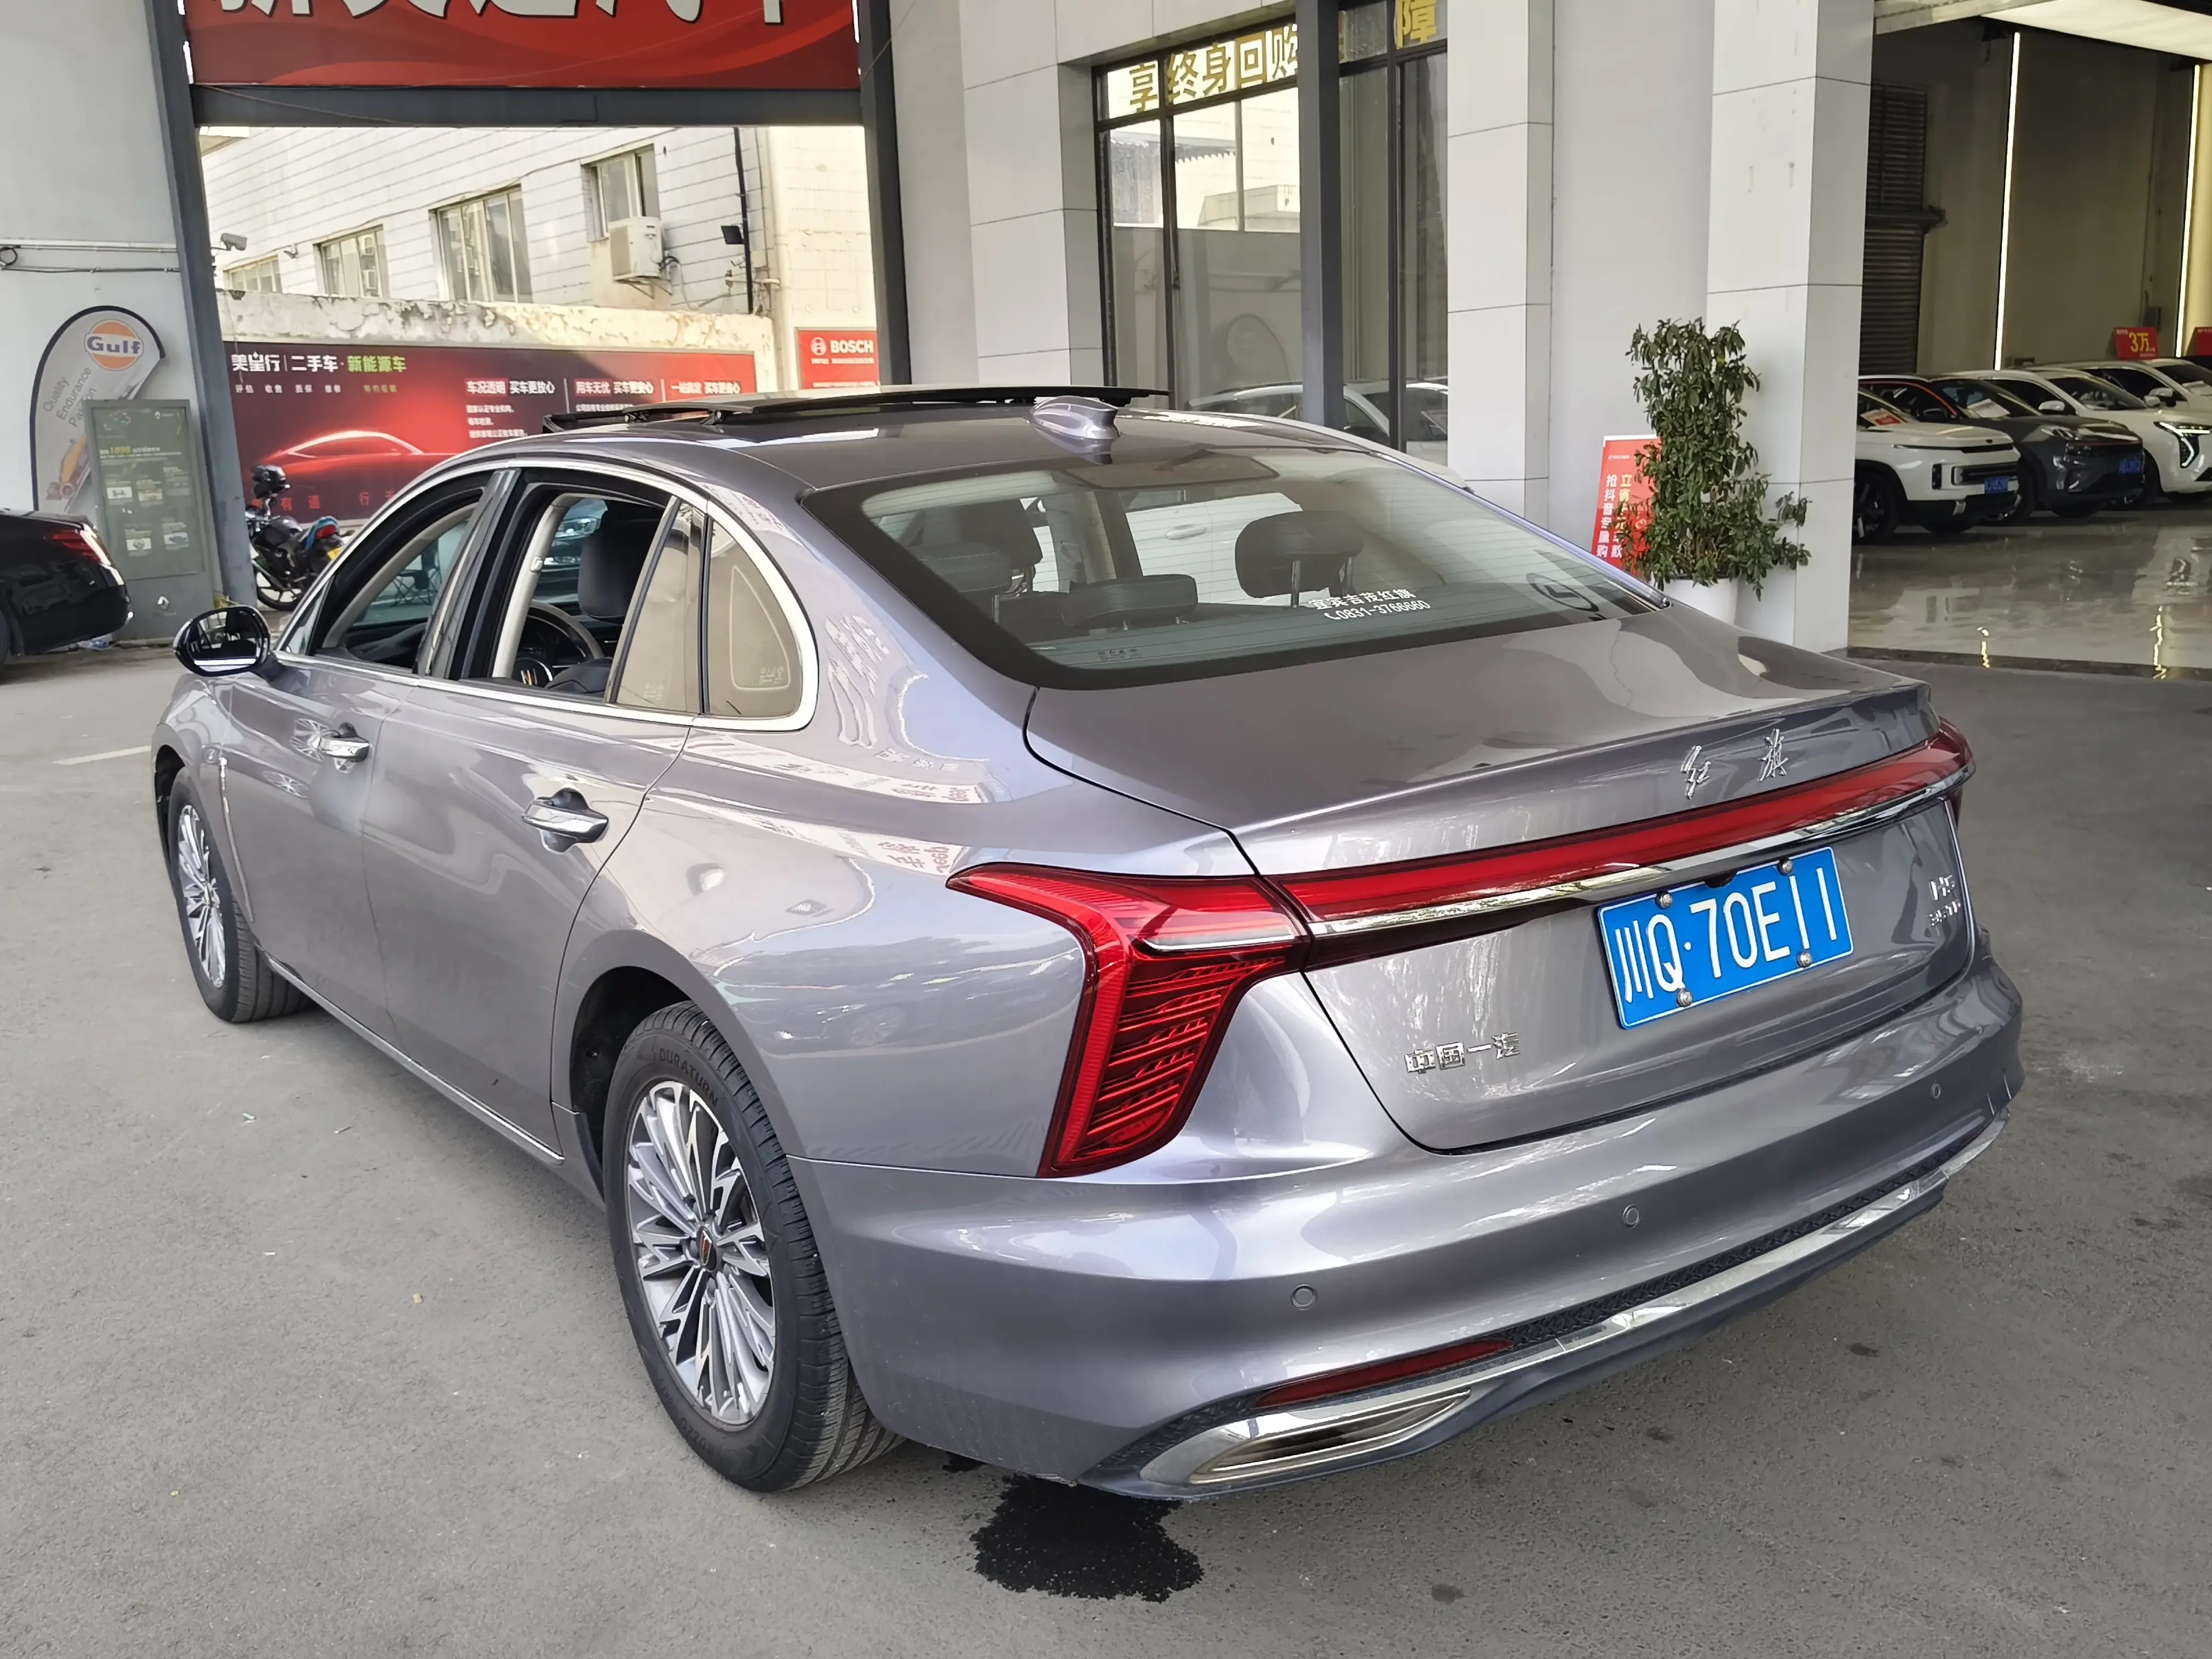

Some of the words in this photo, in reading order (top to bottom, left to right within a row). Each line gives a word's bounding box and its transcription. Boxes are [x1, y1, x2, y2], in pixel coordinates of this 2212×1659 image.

[86, 336, 141, 354] Gulf
[830, 339, 874, 354] BOSCH
[2128, 332, 2150, 353] 3万
[291, 354, 339, 373] 二手车
[347, 355, 407, 373] 新能源车
[43, 376, 70, 412] Quality
[56, 367, 92, 421] Endurance
[69, 388, 97, 427] Pason
[1308, 588, 1417, 610] 宜宾吉茂红旗
[1336, 599, 1432, 620] 0831-3766660
[1404, 1032, 1521, 1074] 中国一汽
[659, 1048, 719, 1107] DURATURN
